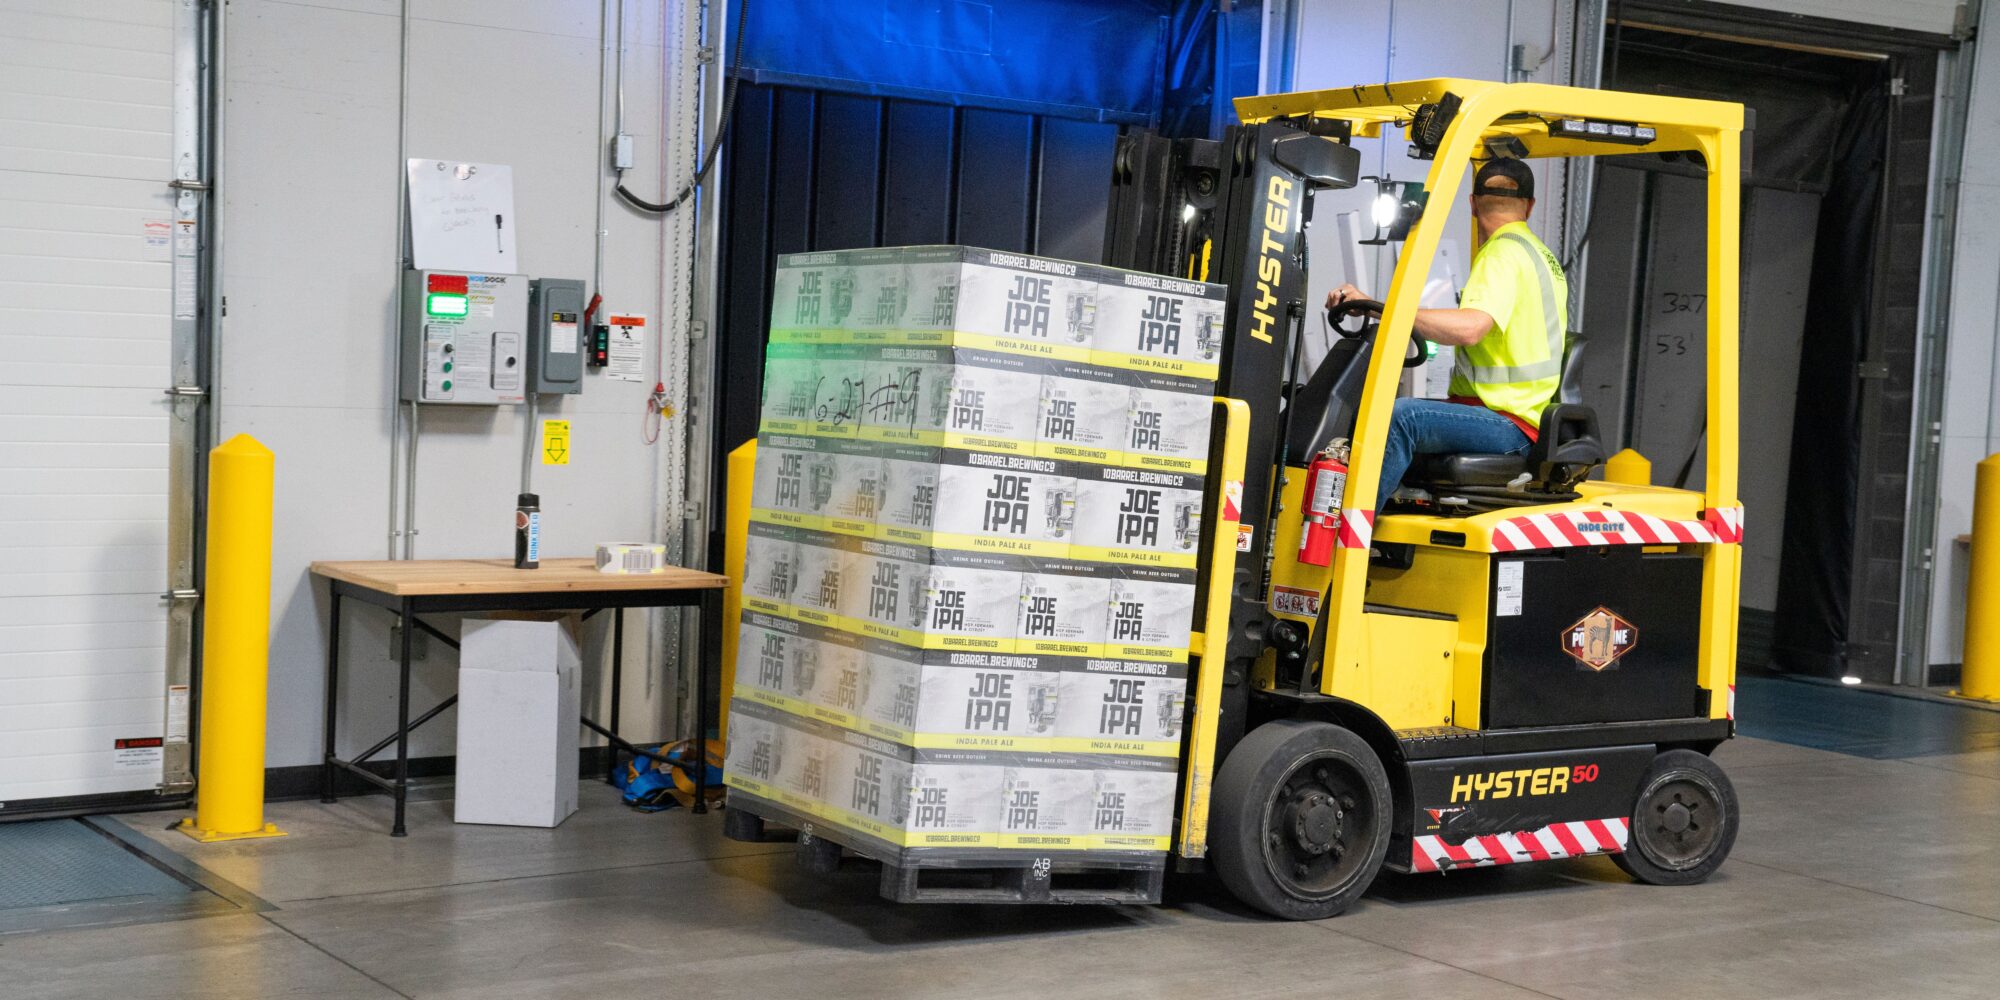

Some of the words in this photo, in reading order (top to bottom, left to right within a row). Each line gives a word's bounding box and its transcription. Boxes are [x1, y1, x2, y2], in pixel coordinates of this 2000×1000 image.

[1251, 176, 1292, 344] HYSTER
[798, 271, 823, 294] JOE
[1008, 276, 1052, 304] JOE
[878, 287, 897, 303] JOE
[934, 286, 954, 303] JOE
[1662, 292, 1706, 314] 327
[795, 295, 821, 324] IPA
[876, 303, 895, 324] IPA
[932, 304, 953, 325] IPA
[1004, 301, 1049, 337] IPA
[1142, 296, 1183, 323] JOE
[995, 340, 1018, 350] INDIA
[1019, 343, 1039, 352] PALE
[1040, 345, 1053, 354] ALE
[1138, 321, 1180, 355] IPA
[1003, 359, 1024, 367] OUTSIDE
[1094, 370, 1114, 378] OUTSIDE
[1129, 358, 1149, 367] INDIA
[1152, 360, 1169, 369] PALE
[1170, 362, 1183, 370] ALE
[1178, 381, 1198, 389] OUTSIDE
[954, 389, 985, 408] JOE
[1048, 400, 1076, 418] JOE
[952, 407, 984, 431] IPA
[1045, 417, 1075, 440] IPA
[1134, 411, 1162, 429] JOE
[1132, 429, 1160, 450] IPA
[778, 453, 802, 477] JOE
[775, 478, 800, 508] IPA
[858, 479, 877, 496] JOE
[913, 486, 933, 504] JOE
[987, 474, 1032, 501] JOE
[855, 496, 874, 518] IPA
[1120, 489, 1161, 514] JOE
[911, 503, 931, 526] IPA
[983, 501, 1028, 534] IPA
[1116, 514, 1158, 546] IPA
[1578, 522, 1600, 532] RIDE
[1602, 522, 1624, 532] RITE
[973, 539, 997, 547] INDIA
[999, 541, 1017, 549] PALE
[1018, 542, 1032, 550] ALE
[1108, 551, 1129, 559] INDIA
[1130, 553, 1148, 561] PALE
[1149, 554, 1162, 562] ALE
[771, 561, 788, 578] JOE
[821, 570, 839, 588] JOE
[872, 561, 900, 589] JOE
[770, 577, 787, 599] IPA
[819, 587, 837, 609] IPA
[935, 590, 966, 608] JOE
[869, 587, 898, 621] IPA
[1028, 597, 1057, 615] JOE
[1116, 602, 1144, 619] JOE
[932, 608, 963, 631] IPA
[1025, 614, 1055, 636] IPA
[1114, 619, 1141, 641] IPA
[762, 633, 785, 660] JOE
[759, 657, 783, 690] IPA
[840, 669, 858, 688] JOE
[896, 684, 915, 704] JOE
[969, 673, 1013, 698] JOE
[1104, 679, 1145, 704] JOE
[837, 686, 856, 710] IPA
[893, 702, 913, 727] IPA
[965, 700, 1011, 731] IPA
[1100, 705, 1142, 735] IPA
[754, 741, 770, 759] JOE
[1114, 742, 1131, 750] PALE
[752, 757, 769, 780] IPA
[805, 757, 823, 775] JOE
[855, 753, 882, 783] JOE
[803, 773, 820, 798] IPA
[1450, 766, 1570, 803] HYSTER
[1572, 764, 1599, 784] 50
[852, 779, 880, 816] IPA
[918, 788, 947, 805] JOE
[1010, 791, 1039, 808] JOE
[1098, 792, 1125, 809] JOE
[915, 806, 946, 827] IPA
[1008, 808, 1037, 829] IPA
[1095, 809, 1123, 830] IPA
[1034, 870, 1048, 878] INC
